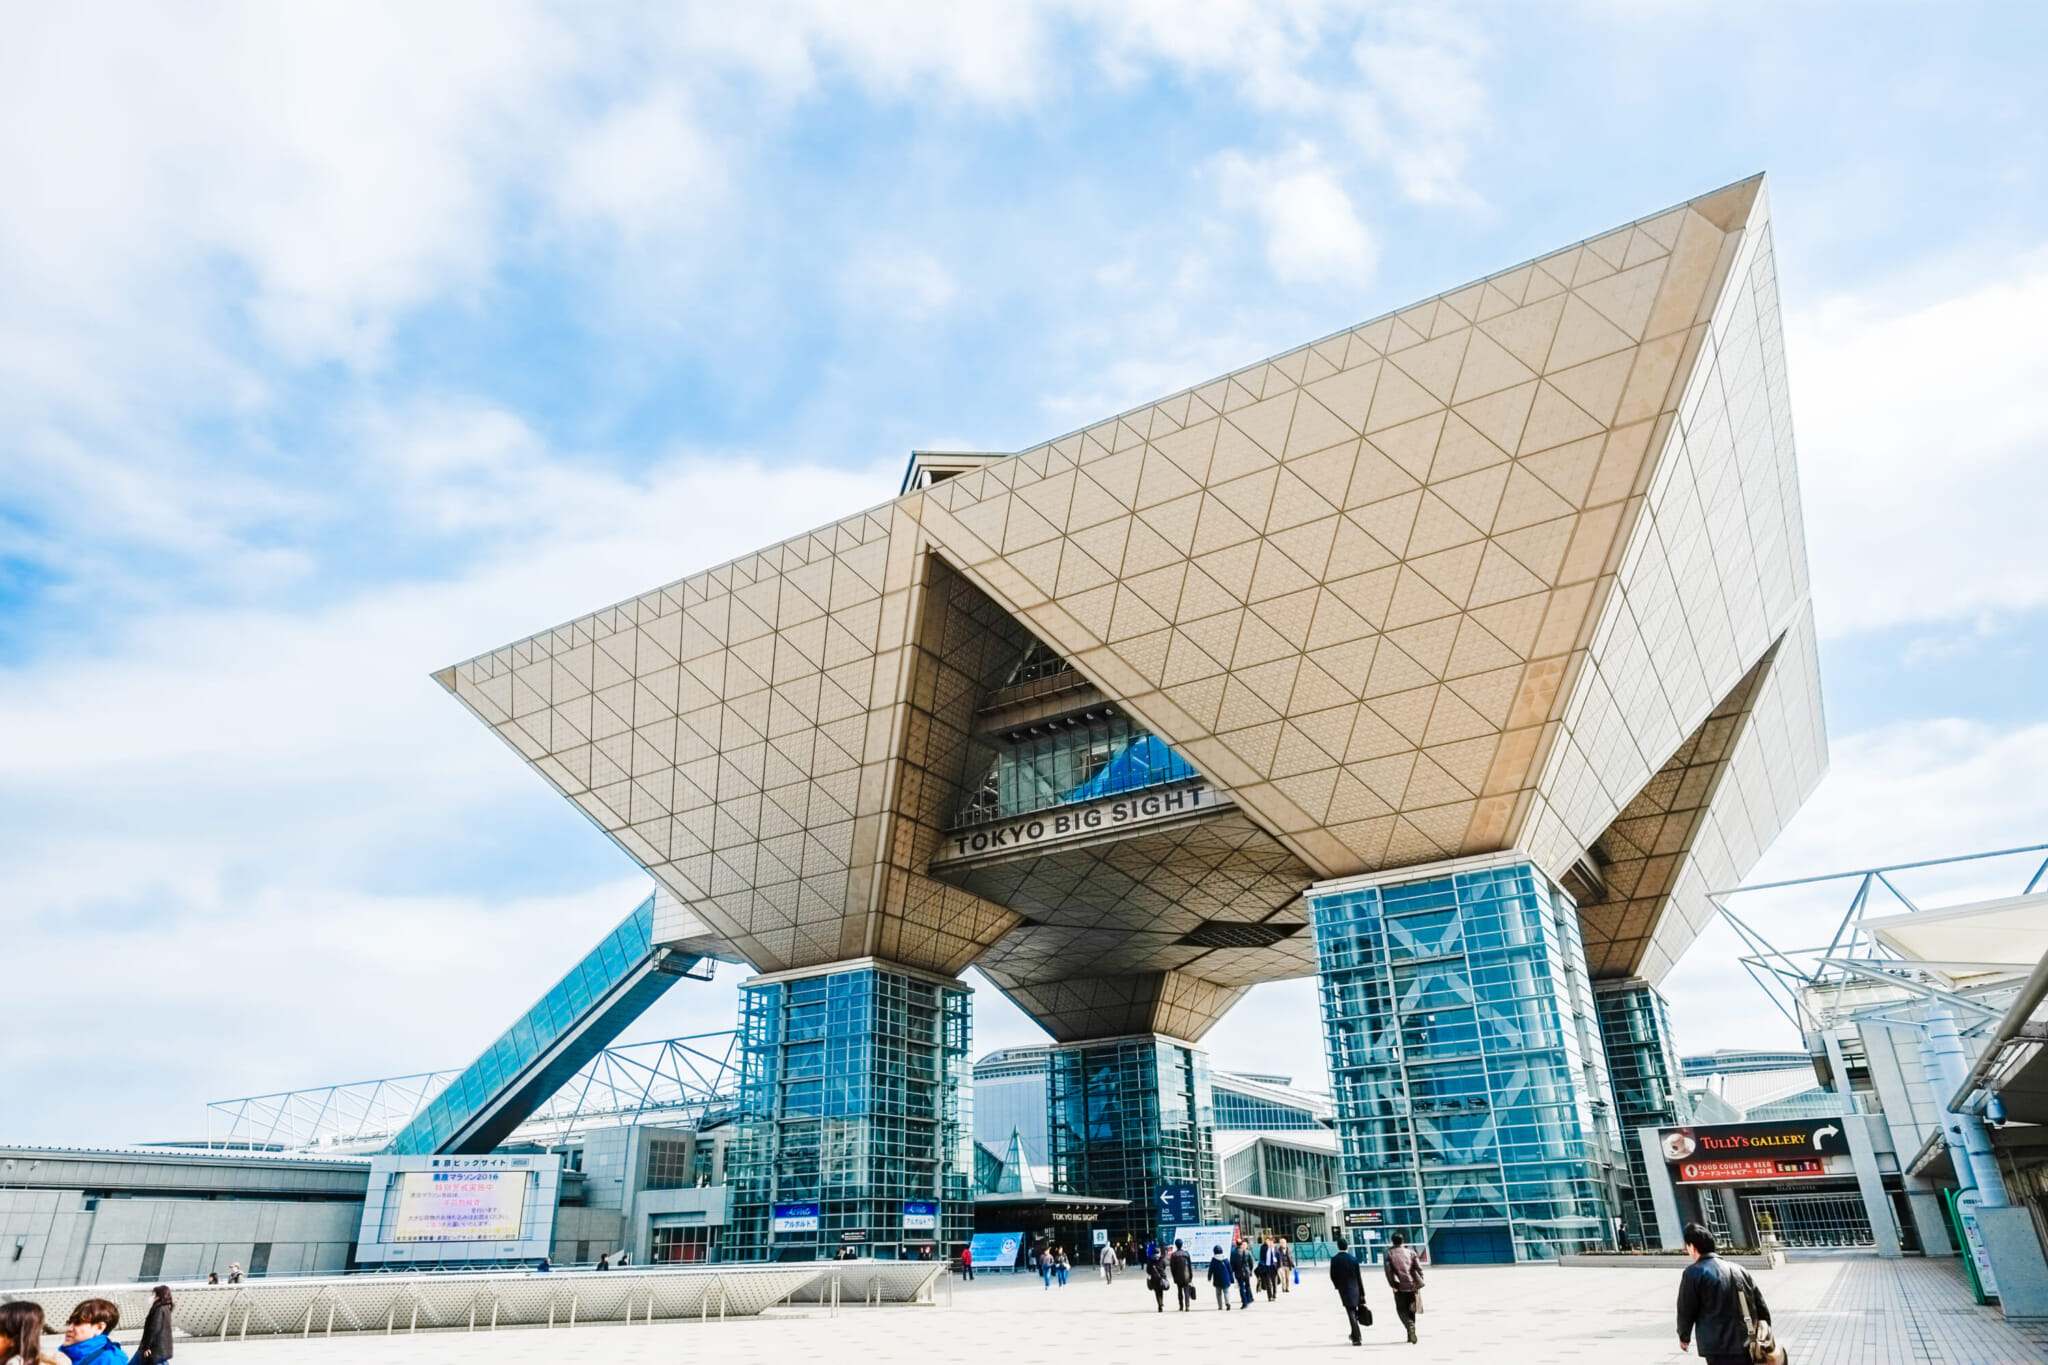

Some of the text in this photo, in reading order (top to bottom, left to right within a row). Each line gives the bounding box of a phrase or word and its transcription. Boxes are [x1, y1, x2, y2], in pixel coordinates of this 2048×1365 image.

[954, 786, 1206, 854] TOKYO BIG SIGHT
[1750, 1134, 1806, 1147] GALLERY
[1698, 1163, 1718, 1171] FOOD
[1052, 1213, 1099, 1221] TOKYO BIG SIGHT
